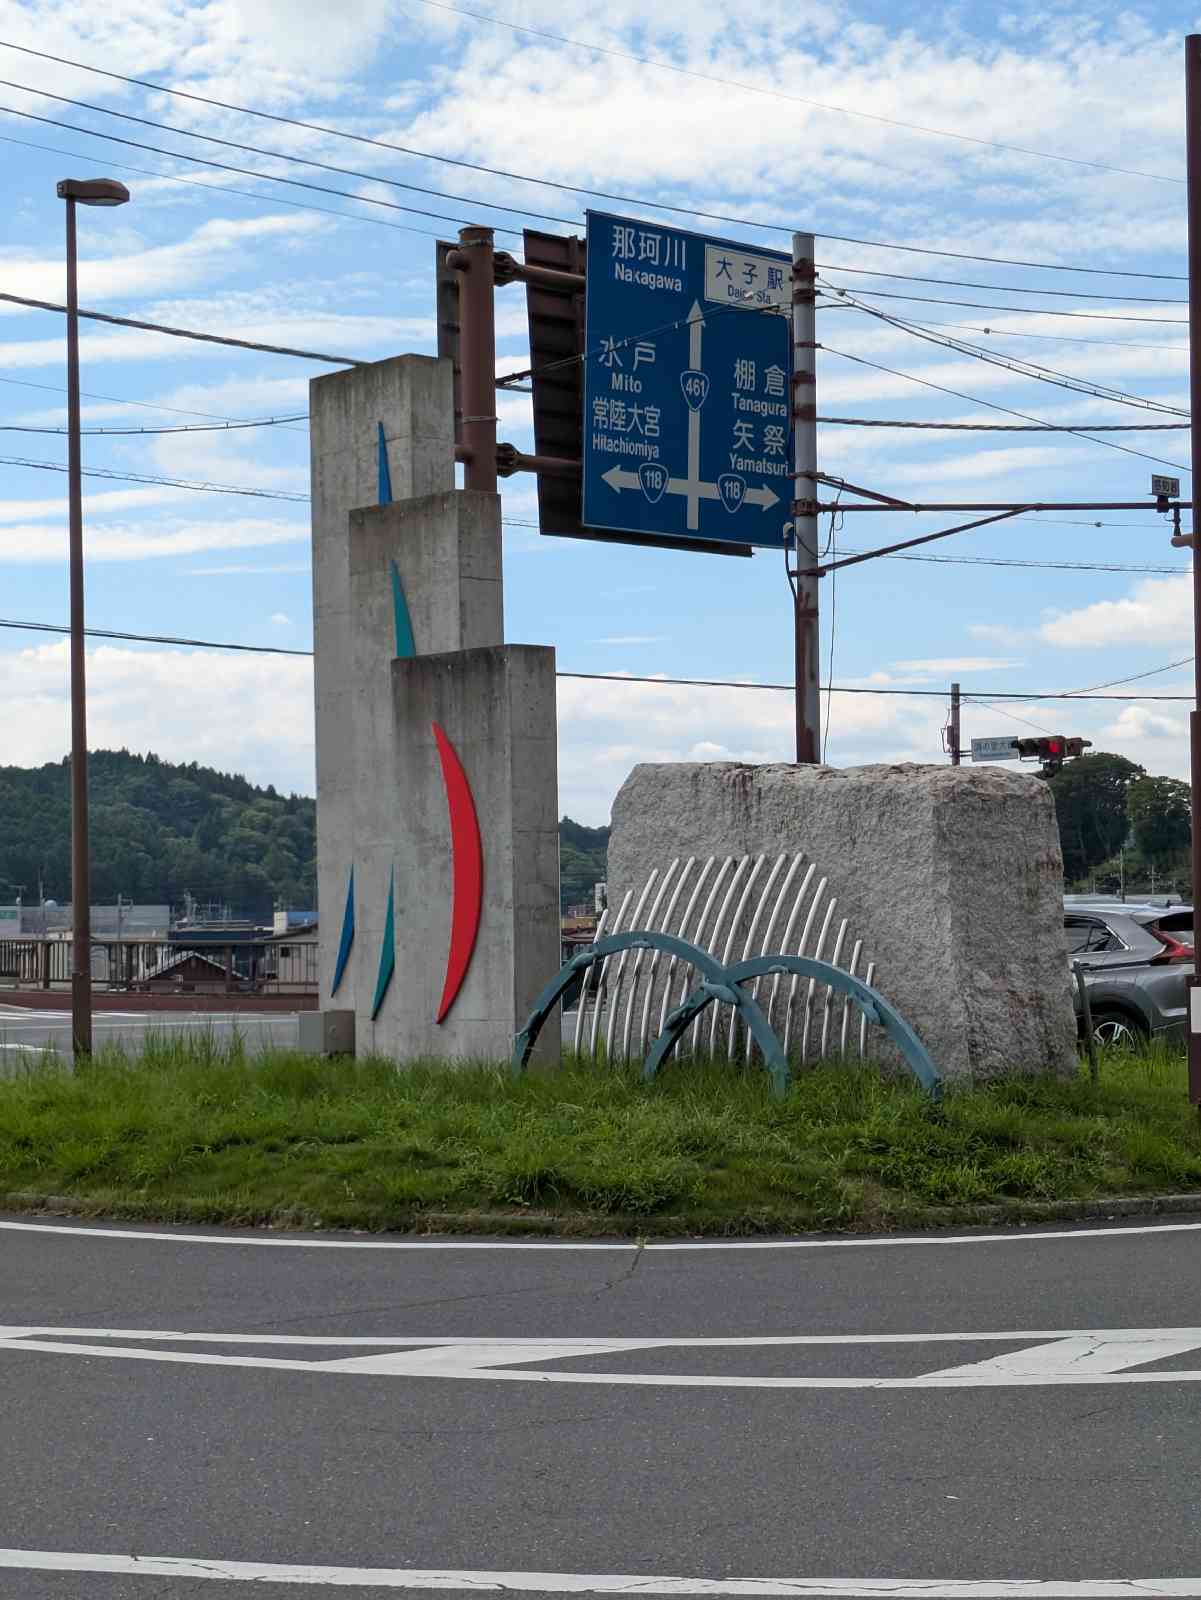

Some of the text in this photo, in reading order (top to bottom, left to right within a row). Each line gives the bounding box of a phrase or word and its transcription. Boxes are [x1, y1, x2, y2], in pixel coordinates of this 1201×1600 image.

[612, 225, 686, 271] 那珂川
[614, 264, 682, 292] Nakagawa
[715, 256, 783, 291] 大子駅
[598, 336, 656, 371] 水戸
[611, 373, 643, 393] Mito
[686, 378, 705, 397] 461
[734, 359, 786, 397] 棚倉
[592, 397, 661, 437] 常陸大宮
[731, 392, 788, 418] Tanagura
[592, 434, 660, 461] Hitachiomiya
[732, 419, 785, 456] 矢祭
[729, 452, 789, 476] Yamatsuri
[645, 470, 662, 487] 118
[724, 482, 741, 501] 118
